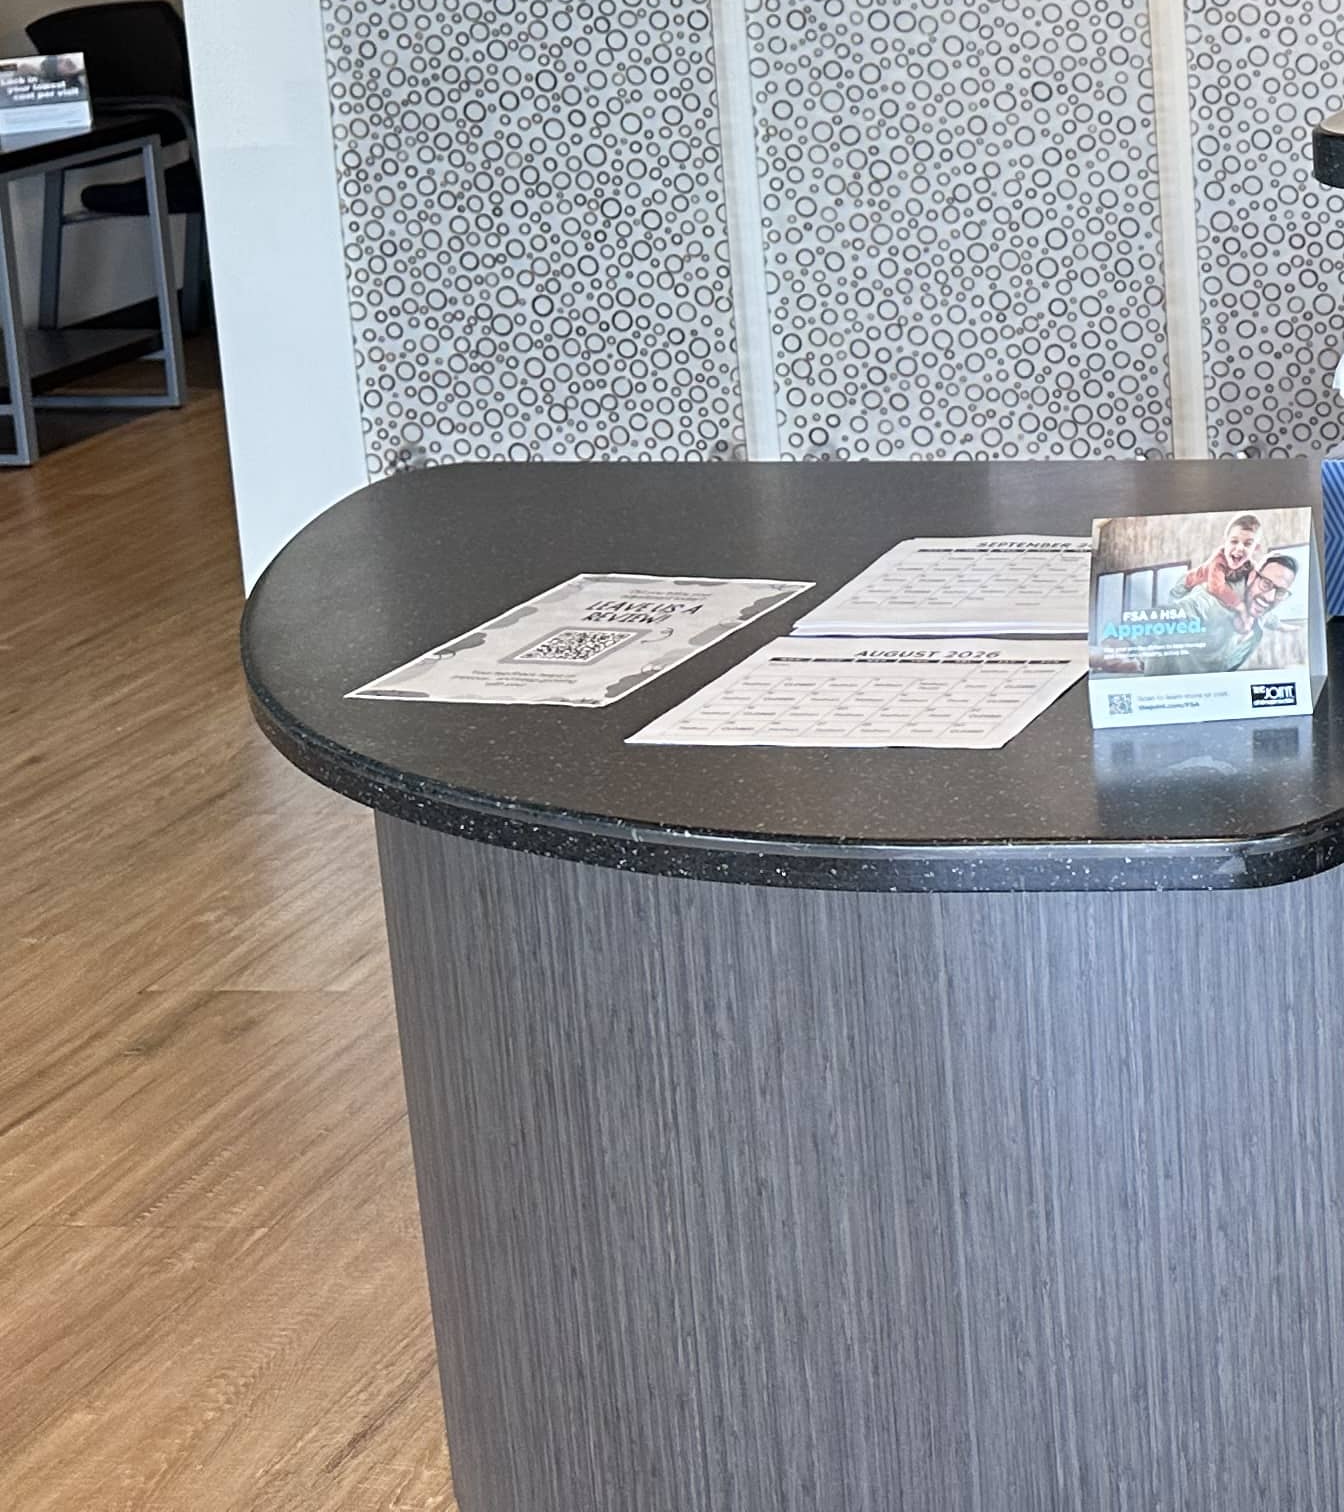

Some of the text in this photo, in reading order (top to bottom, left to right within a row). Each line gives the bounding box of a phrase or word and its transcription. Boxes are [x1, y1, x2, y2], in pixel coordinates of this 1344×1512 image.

[585, 601, 704, 615] LEAVE US A
[1122, 608, 1187, 622] FSA & HSA
[582, 611, 672, 624] REVIEW!
[1102, 616, 1207, 640] Approved.
[855, 650, 1001, 659] AUGUST 2026
